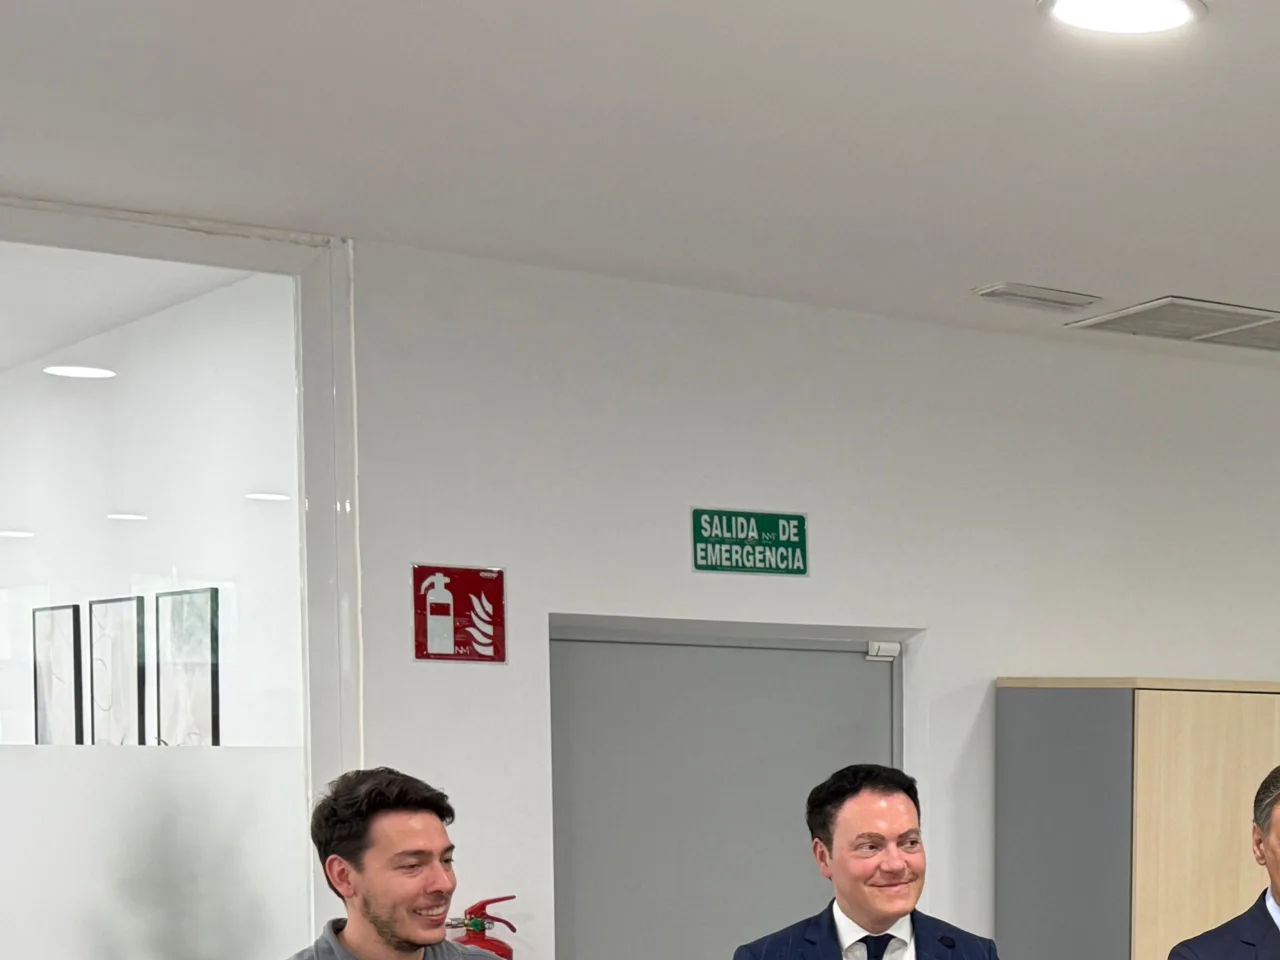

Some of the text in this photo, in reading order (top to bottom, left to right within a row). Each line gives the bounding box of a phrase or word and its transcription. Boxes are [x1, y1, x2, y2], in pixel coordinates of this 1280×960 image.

[701, 514, 799, 541] SALIDA DE
[696, 543, 804, 570] EMERGENCIA
